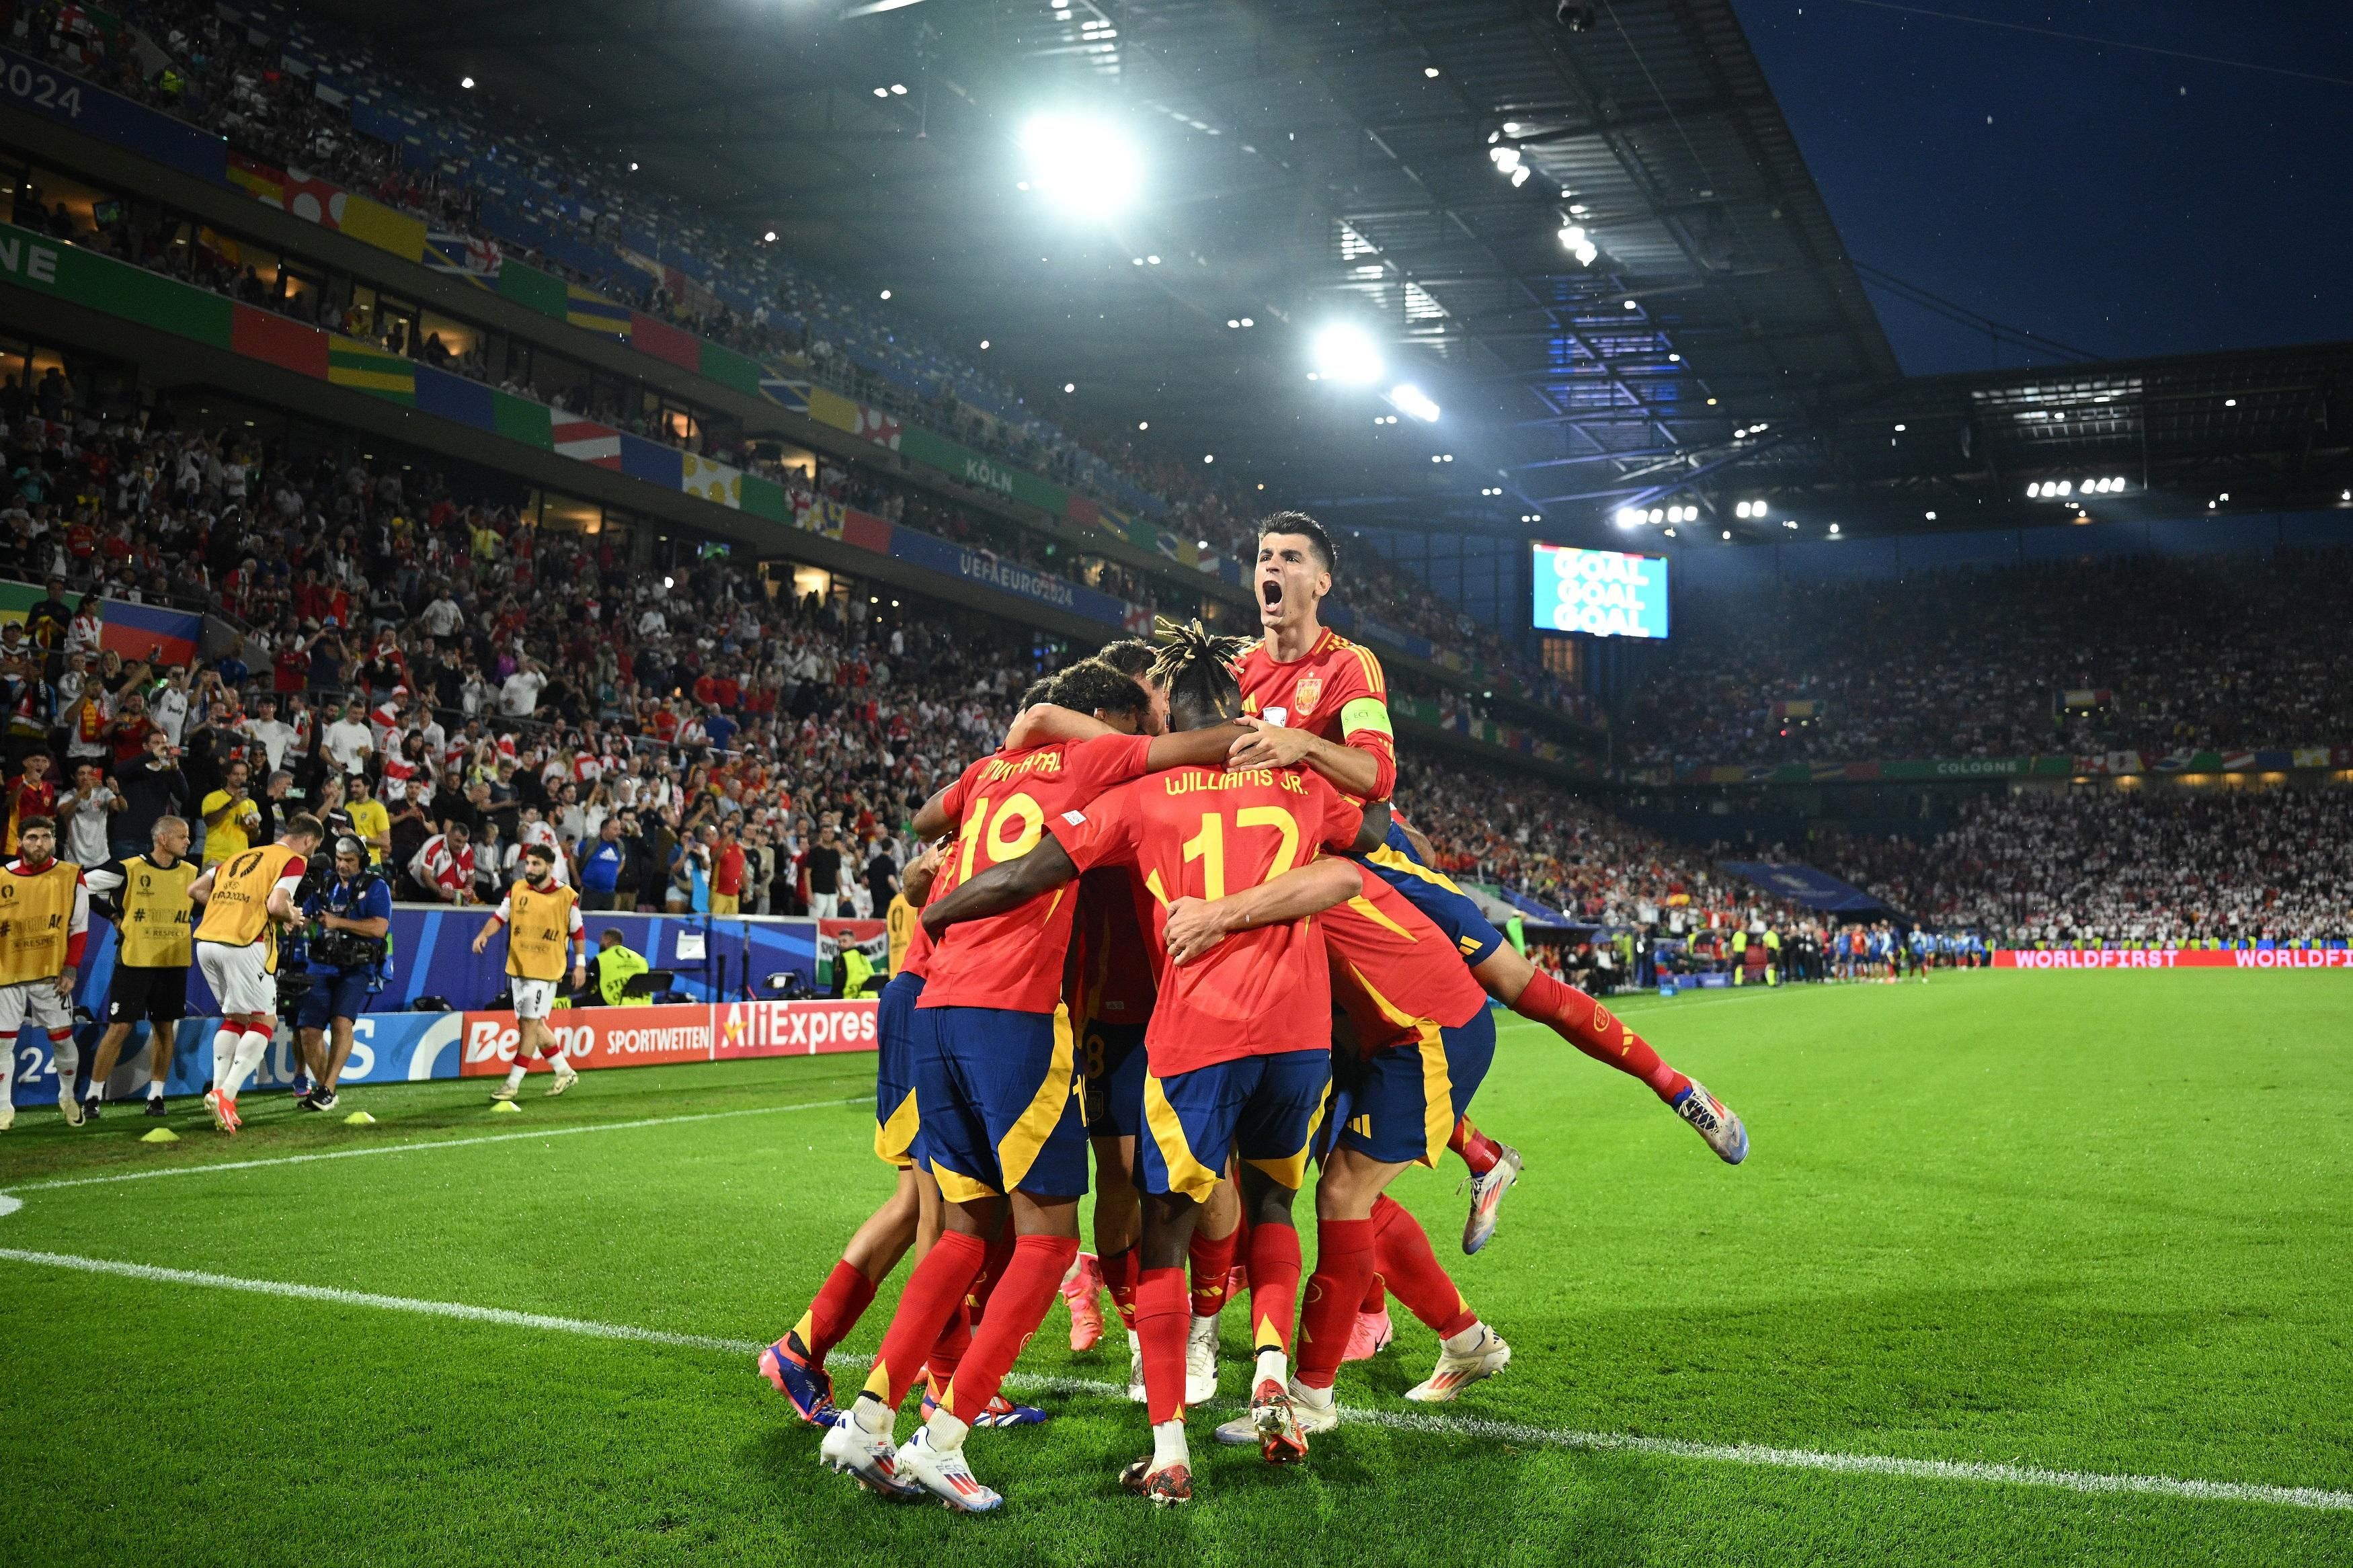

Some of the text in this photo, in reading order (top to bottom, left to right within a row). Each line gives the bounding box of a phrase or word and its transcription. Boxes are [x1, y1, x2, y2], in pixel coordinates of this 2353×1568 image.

[966, 458, 1012, 494] KÖLN
[1553, 550, 1650, 586] GOAL
[1557, 578, 1646, 611] GOAL
[1553, 603, 1650, 638] GOAL
[1165, 768, 1309, 796] WILLIAMS JR.
[1936, 760, 2017, 774] COLOGNE
[1183, 805, 1300, 903] 17
[2015, 950, 2179, 968] WORLDFIRST
[465, 1021, 709, 1064] Beno SPORTWETTEN
[721, 1002, 876, 1055] AliExpres
